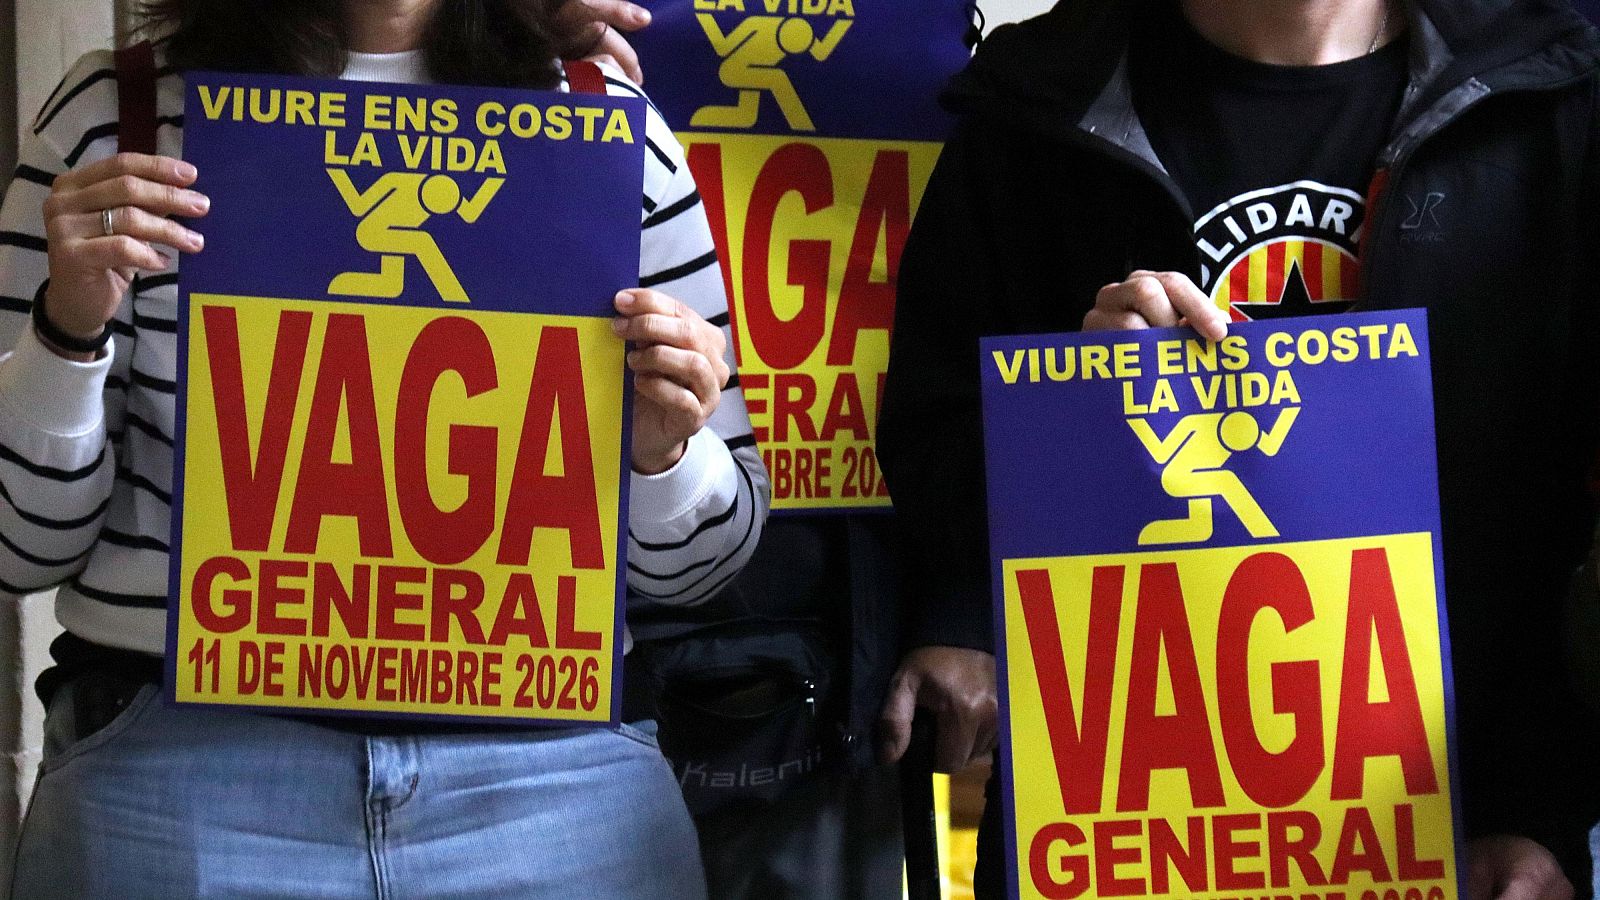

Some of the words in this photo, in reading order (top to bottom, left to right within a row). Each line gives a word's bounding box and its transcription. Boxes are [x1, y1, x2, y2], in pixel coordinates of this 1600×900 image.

[198, 85, 347, 127] VIURE
[364, 94, 459, 134] ENS
[475, 101, 634, 144] COSTA
[324, 130, 382, 167] LA
[397, 134, 507, 174] VIDA
[992, 343, 1142, 384] VIURE
[1157, 335, 1250, 375] ENS
[1265, 323, 1419, 367] COSTA
[1122, 379, 1179, 415] LA
[1191, 370, 1301, 410] VIDA
[202, 305, 606, 570] VAGA
[191, 556, 603, 651] GENERAL
[188, 638, 221, 694] 11
[237, 640, 285, 697] DE
[298, 643, 503, 707] NOVEMBRE
[513, 653, 599, 712] 2026
[1015, 547, 1440, 815] VAGA
[1028, 803, 1445, 900] GENERAL
